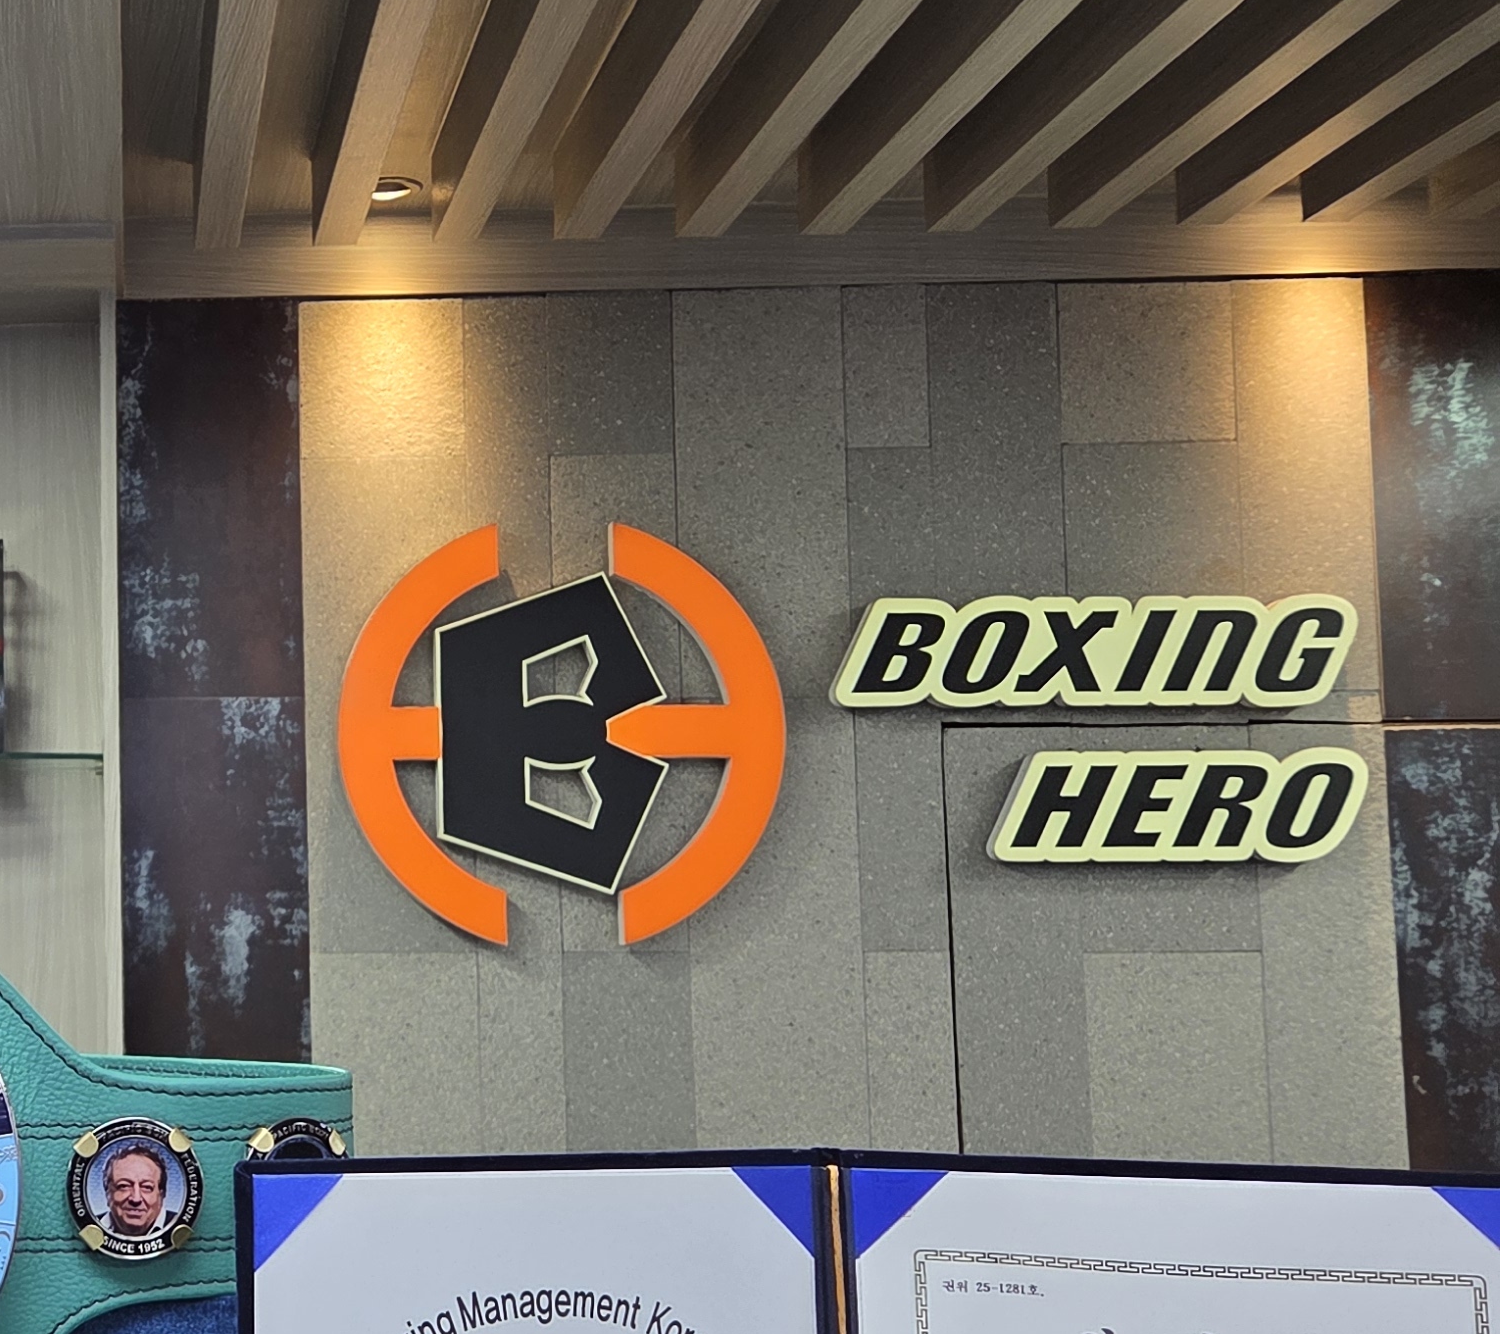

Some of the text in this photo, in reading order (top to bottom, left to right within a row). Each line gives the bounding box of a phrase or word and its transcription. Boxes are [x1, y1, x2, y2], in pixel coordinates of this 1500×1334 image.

[850, 607, 1344, 694] BOXING
[1010, 762, 1354, 848] HERO
[103, 1235, 167, 1255] SINCE 1952
[455, 1288, 642, 1332] Management
